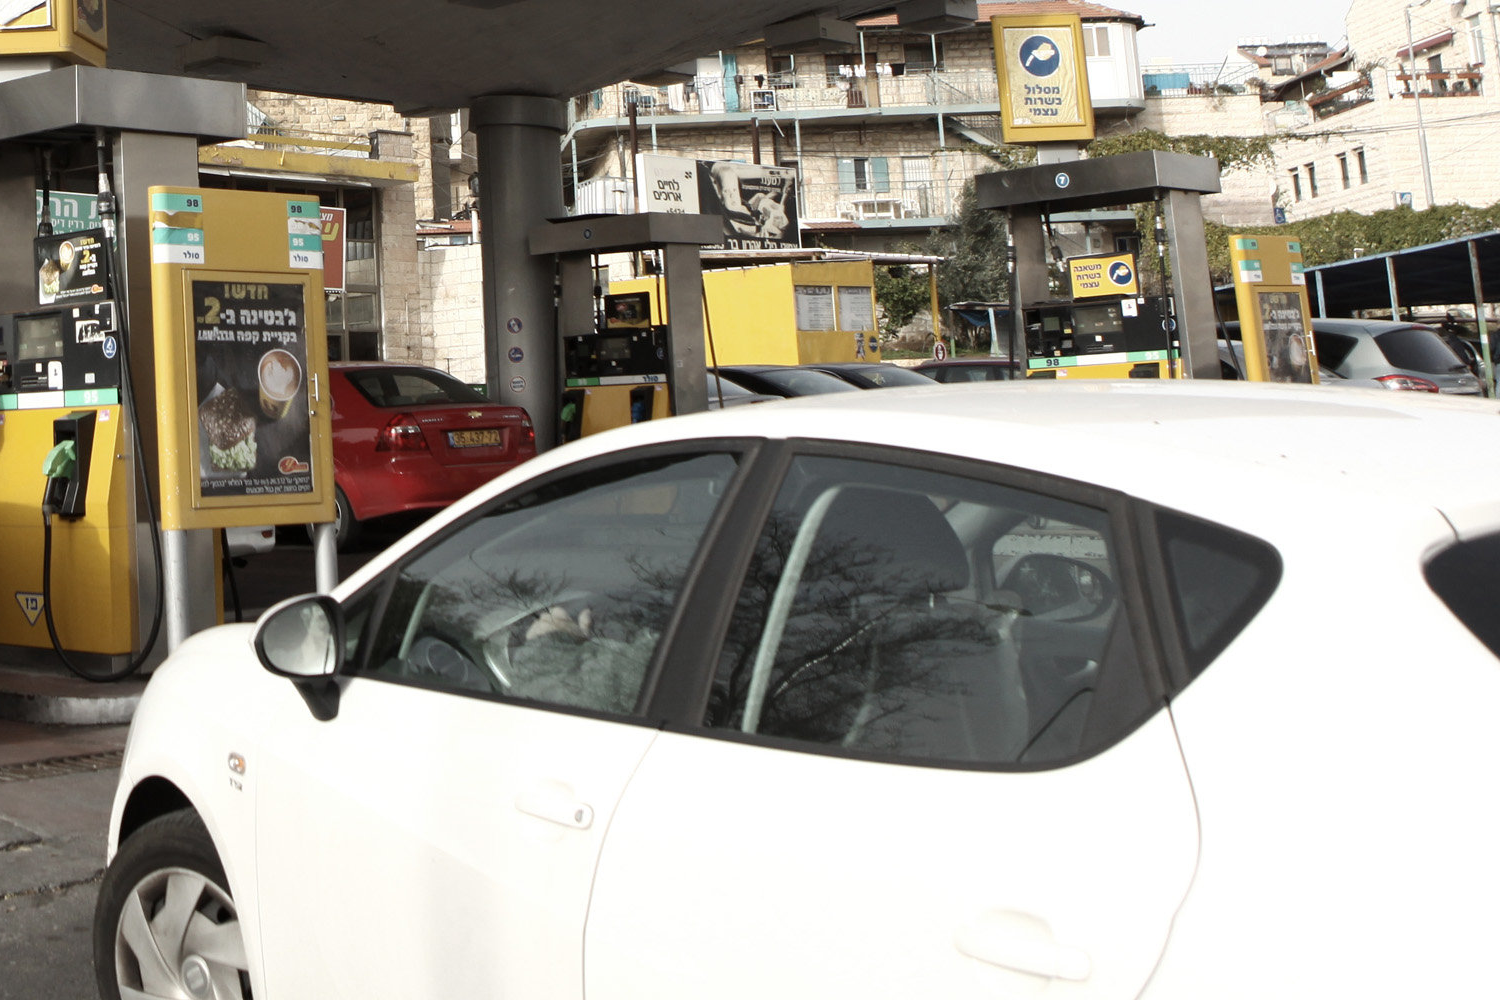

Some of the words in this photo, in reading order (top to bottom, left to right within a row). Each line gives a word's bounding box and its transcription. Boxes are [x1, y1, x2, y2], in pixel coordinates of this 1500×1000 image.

[1024, 84, 1060, 95] מסלול
[1024, 97, 1062, 106] בשרות
[1029, 107, 1058, 117] עצמי
[657, 179, 680, 191] לחיים
[653, 190, 683, 202] ארוכים
[186, 199, 199, 207] 98
[290, 205, 302, 213] 98
[187, 232, 200, 242] 95
[292, 238, 304, 247] 95
[183, 251, 200, 260] סולר
[293, 254, 309, 263] סולר
[1074, 263, 1102, 273] משאבה
[1076, 272, 1102, 281] בשרות
[1080, 281, 1100, 289] עצמי
[236, 331, 260, 345] קפה
[262, 331, 297, 346] בקניית
[1046, 358, 1060, 367] 98
[83, 391, 98, 404] 95
